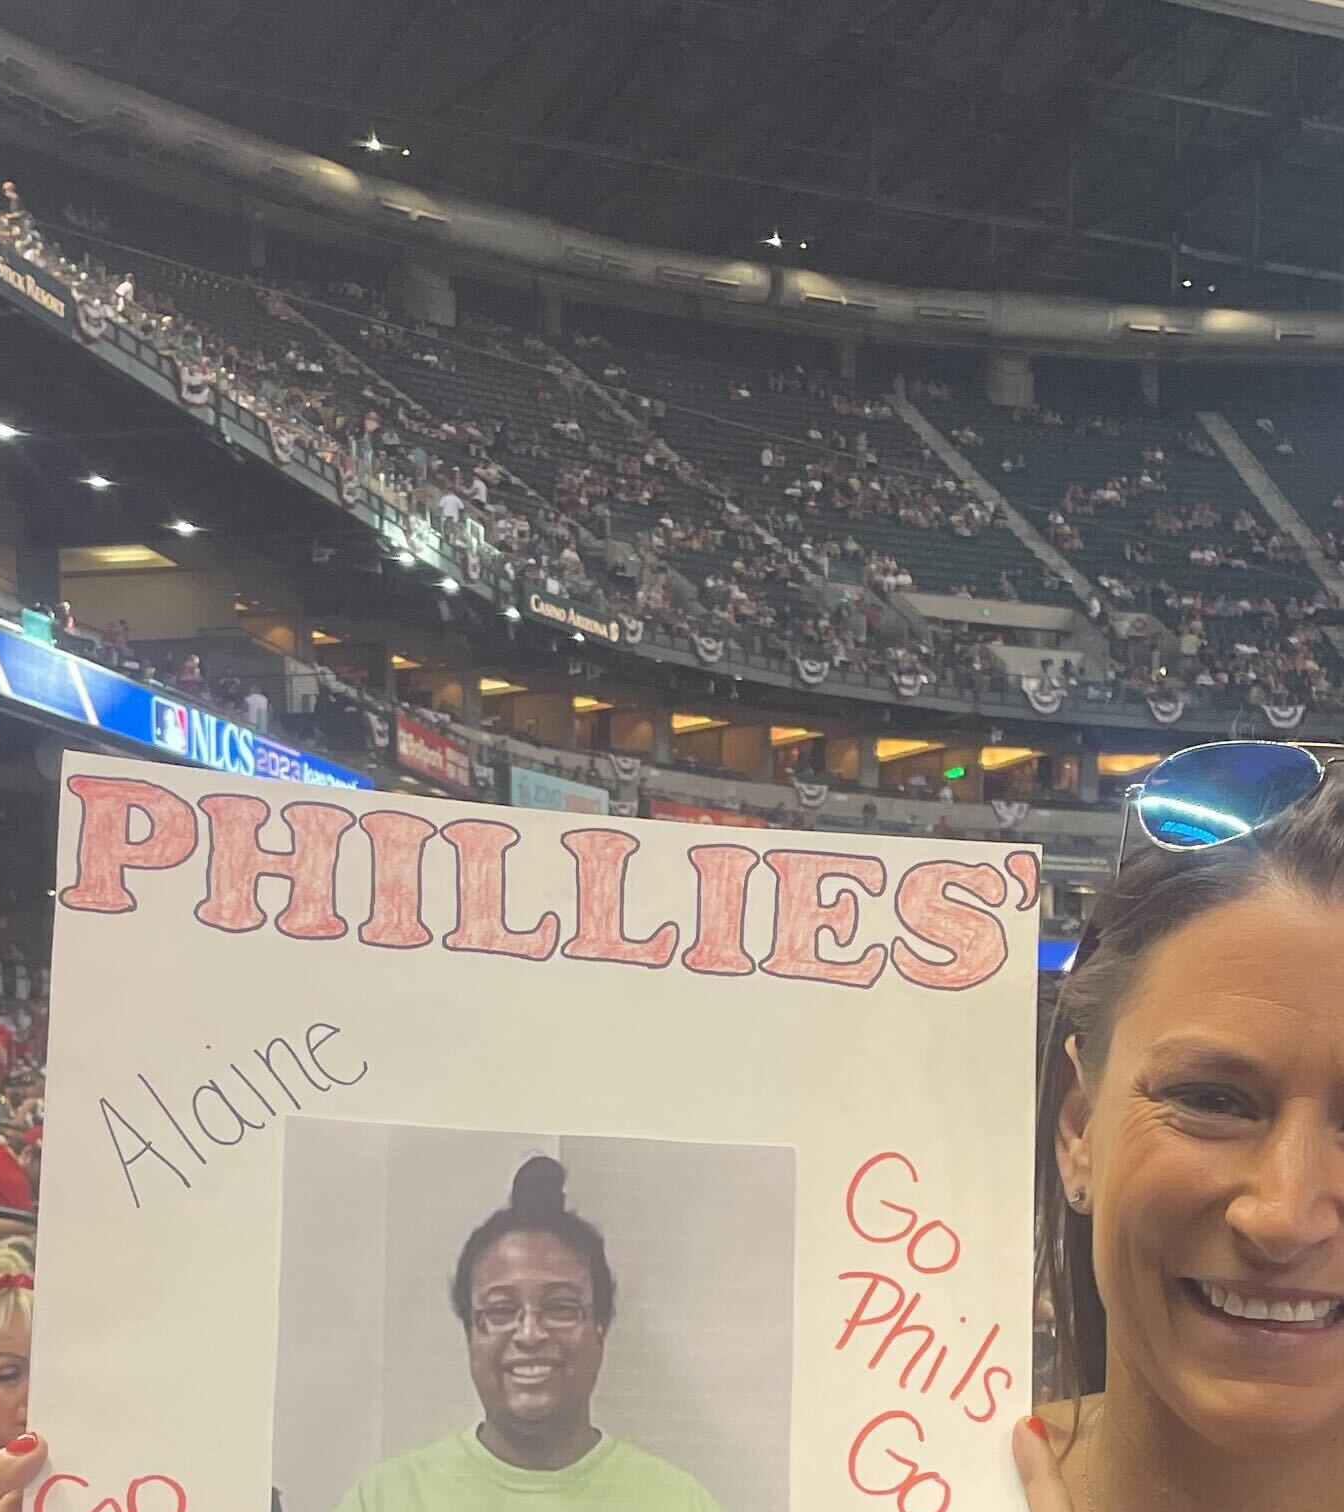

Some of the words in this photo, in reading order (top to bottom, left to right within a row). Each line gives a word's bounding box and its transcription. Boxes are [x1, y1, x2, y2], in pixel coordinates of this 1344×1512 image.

[190, 709, 256, 777] NLCS
[58, 774, 1041, 992] PHILLIES'
[99, 1022, 369, 1209] Alaine
[834, 1271, 1013, 1424] Phils
